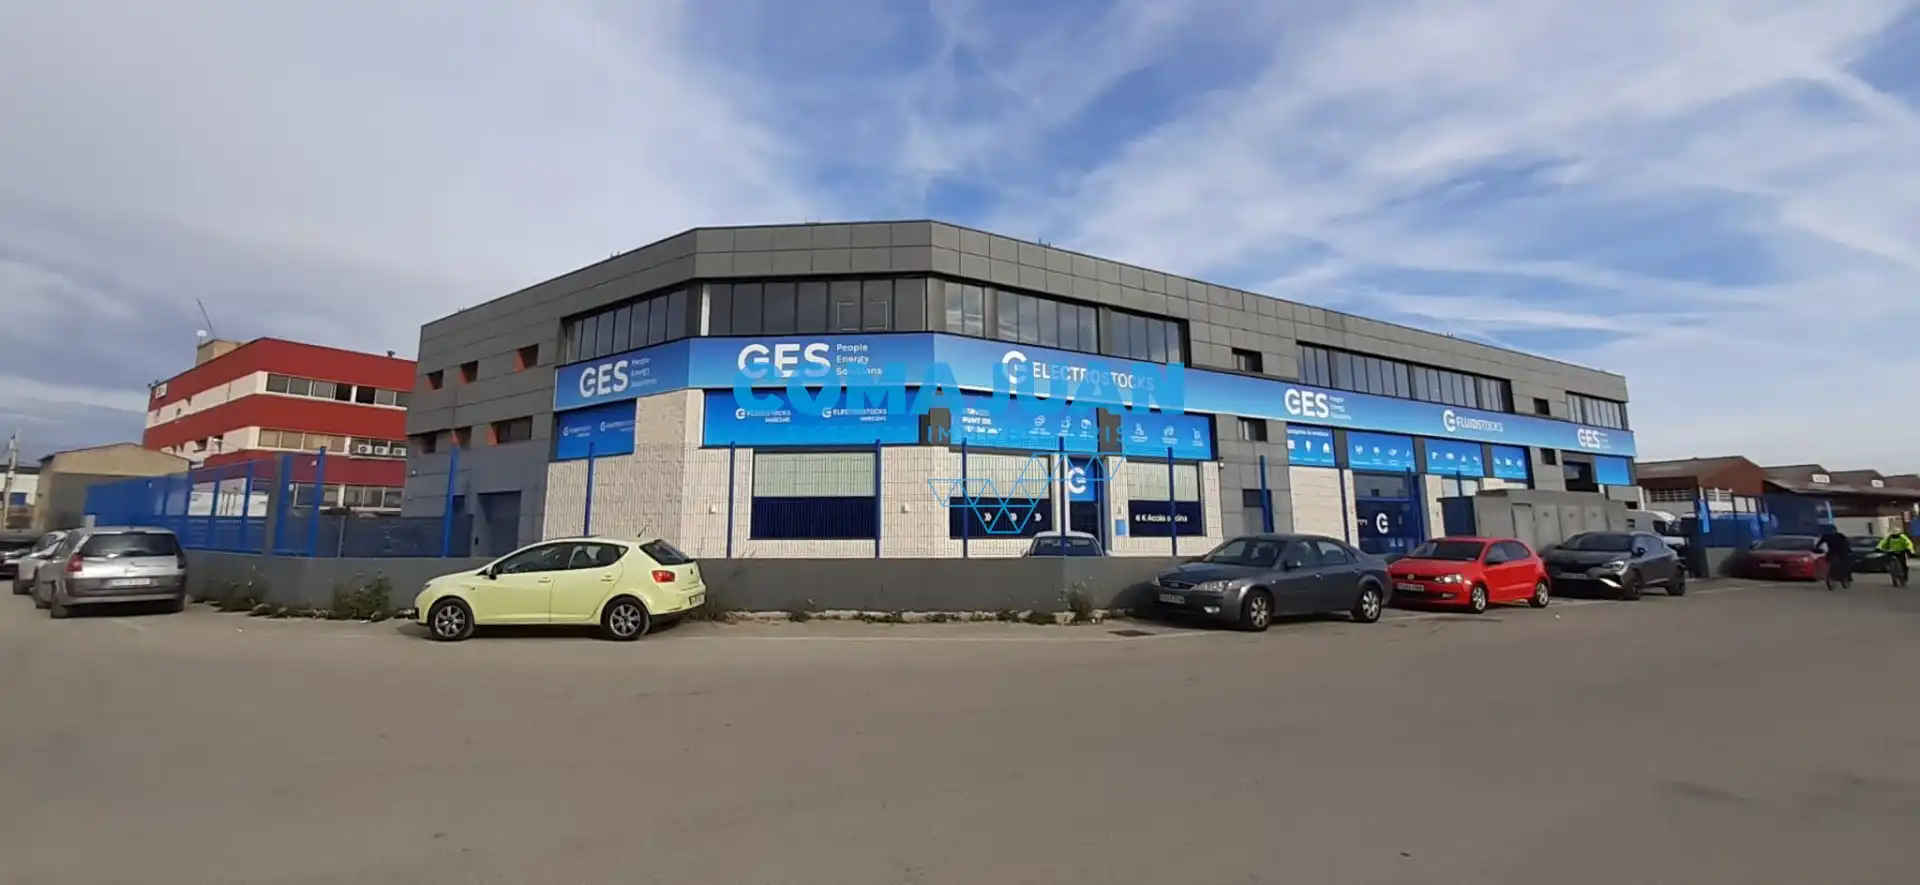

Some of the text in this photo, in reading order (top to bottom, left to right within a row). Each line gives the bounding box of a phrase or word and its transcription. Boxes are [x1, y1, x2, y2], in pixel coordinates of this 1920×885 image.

[738, 343, 831, 379] GES
[836, 344, 868, 352] People
[836, 355, 869, 365] Energy
[579, 360, 629, 398] GES
[1032, 361, 1155, 391] ELECTROSTOCKS
[1284, 388, 1329, 418] GES
[1577, 428, 1601, 449] GES
